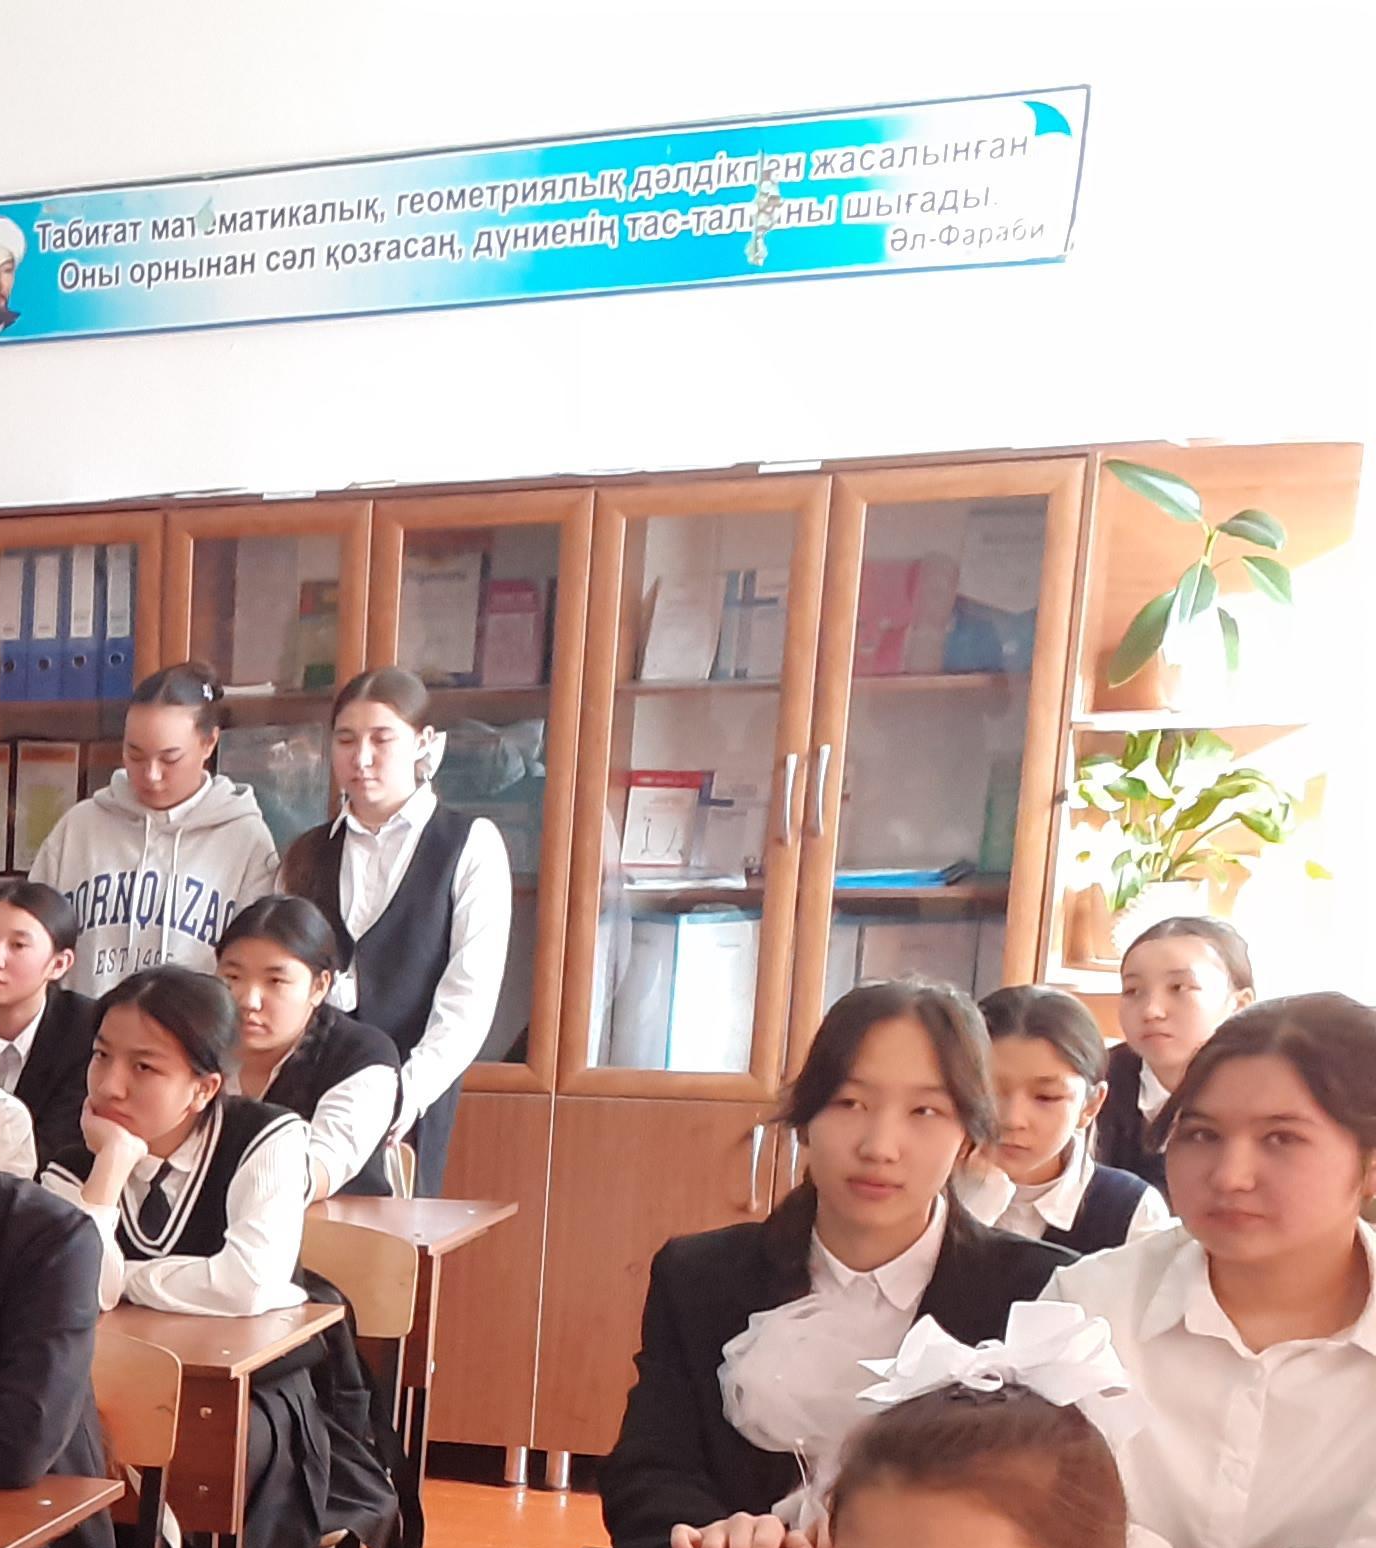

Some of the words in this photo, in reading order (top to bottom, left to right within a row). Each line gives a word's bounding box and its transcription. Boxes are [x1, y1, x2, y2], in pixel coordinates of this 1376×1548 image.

[37, 217, 141, 253] Табиғат
[151, 193, 384, 240] матматикалық,
[397, 166, 623, 219] геометриялық
[813, 136, 1028, 176] жасалынған
[59, 257, 121, 291] Оны
[130, 246, 256, 289] орнынан
[265, 243, 315, 274] сәл
[325, 229, 464, 273] қозғасаң,
[473, 208, 617, 260] дүниенің
[627, 196, 834, 238] тас-талны
[95, 948, 129, 976] EST
